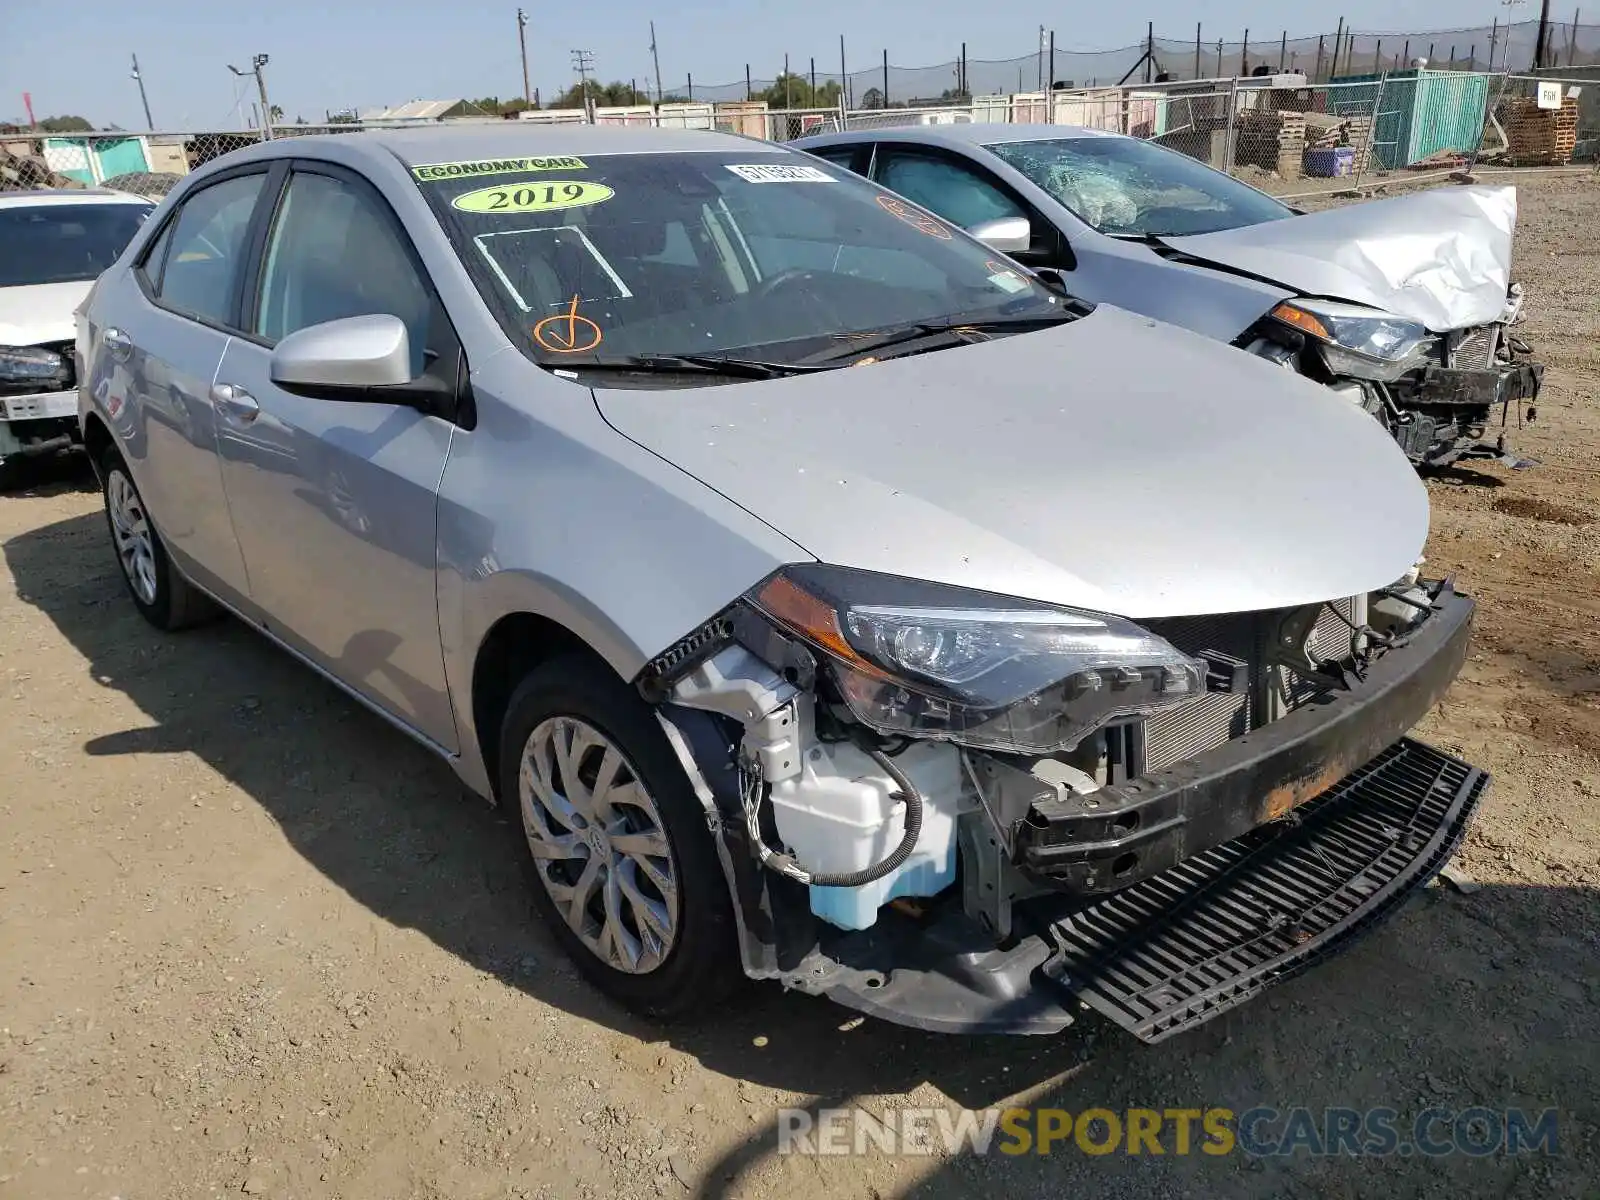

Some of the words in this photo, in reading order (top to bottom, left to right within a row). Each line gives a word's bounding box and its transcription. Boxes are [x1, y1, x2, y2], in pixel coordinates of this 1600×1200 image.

[418, 159, 528, 179] ECONOMY
[531, 156, 577, 169] CAR
[487, 184, 584, 210] 2019
